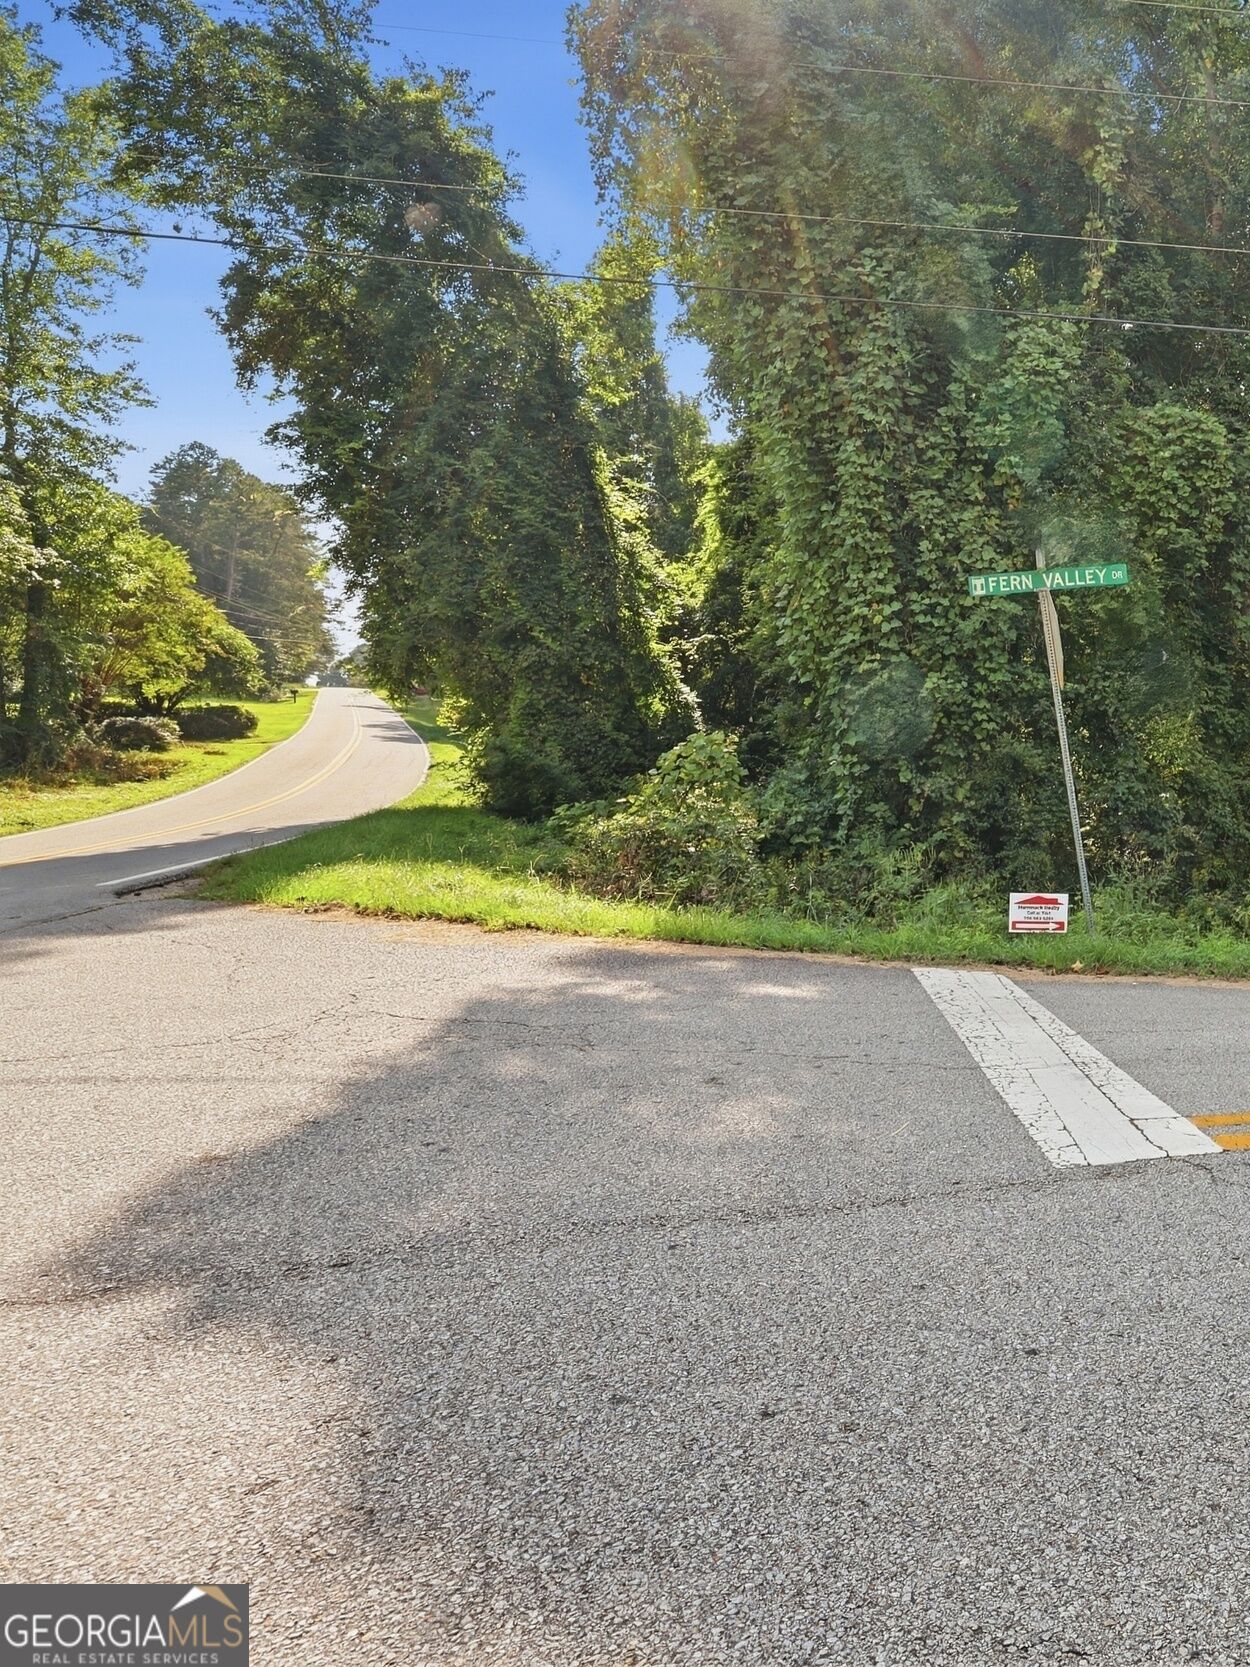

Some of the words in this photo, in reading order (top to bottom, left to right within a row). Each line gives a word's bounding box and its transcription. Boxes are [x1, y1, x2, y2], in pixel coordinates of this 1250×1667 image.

[988, 574, 1033, 592] FERN
[1042, 568, 1107, 588] VALLEY
[1111, 570, 1123, 579] DR
